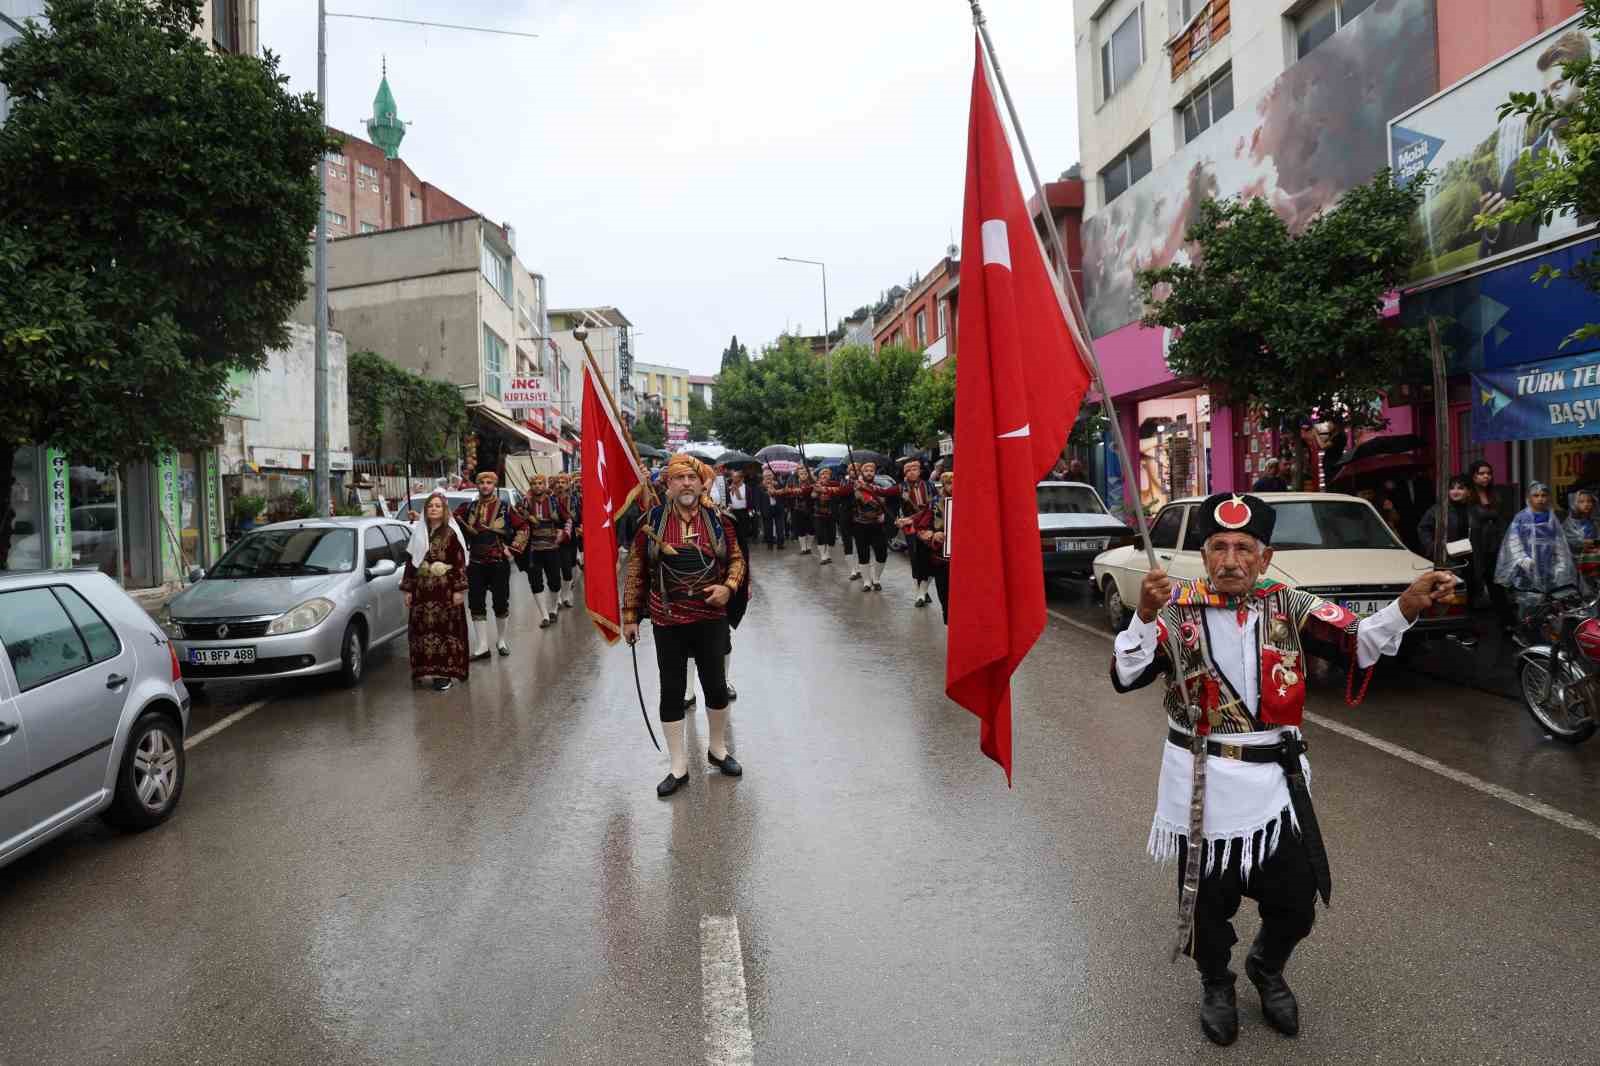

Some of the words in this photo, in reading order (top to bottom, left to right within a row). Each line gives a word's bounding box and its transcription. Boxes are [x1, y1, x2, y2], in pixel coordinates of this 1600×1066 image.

[1398, 140, 1428, 169] Mobil
[1517, 368, 1566, 396] TÜRK
[1572, 364, 1600, 388] TE
[1548, 398, 1600, 429] BAŞV
[195, 651, 207, 661] 01
[210, 650, 231, 661] BFP
[233, 649, 254, 660] 488
